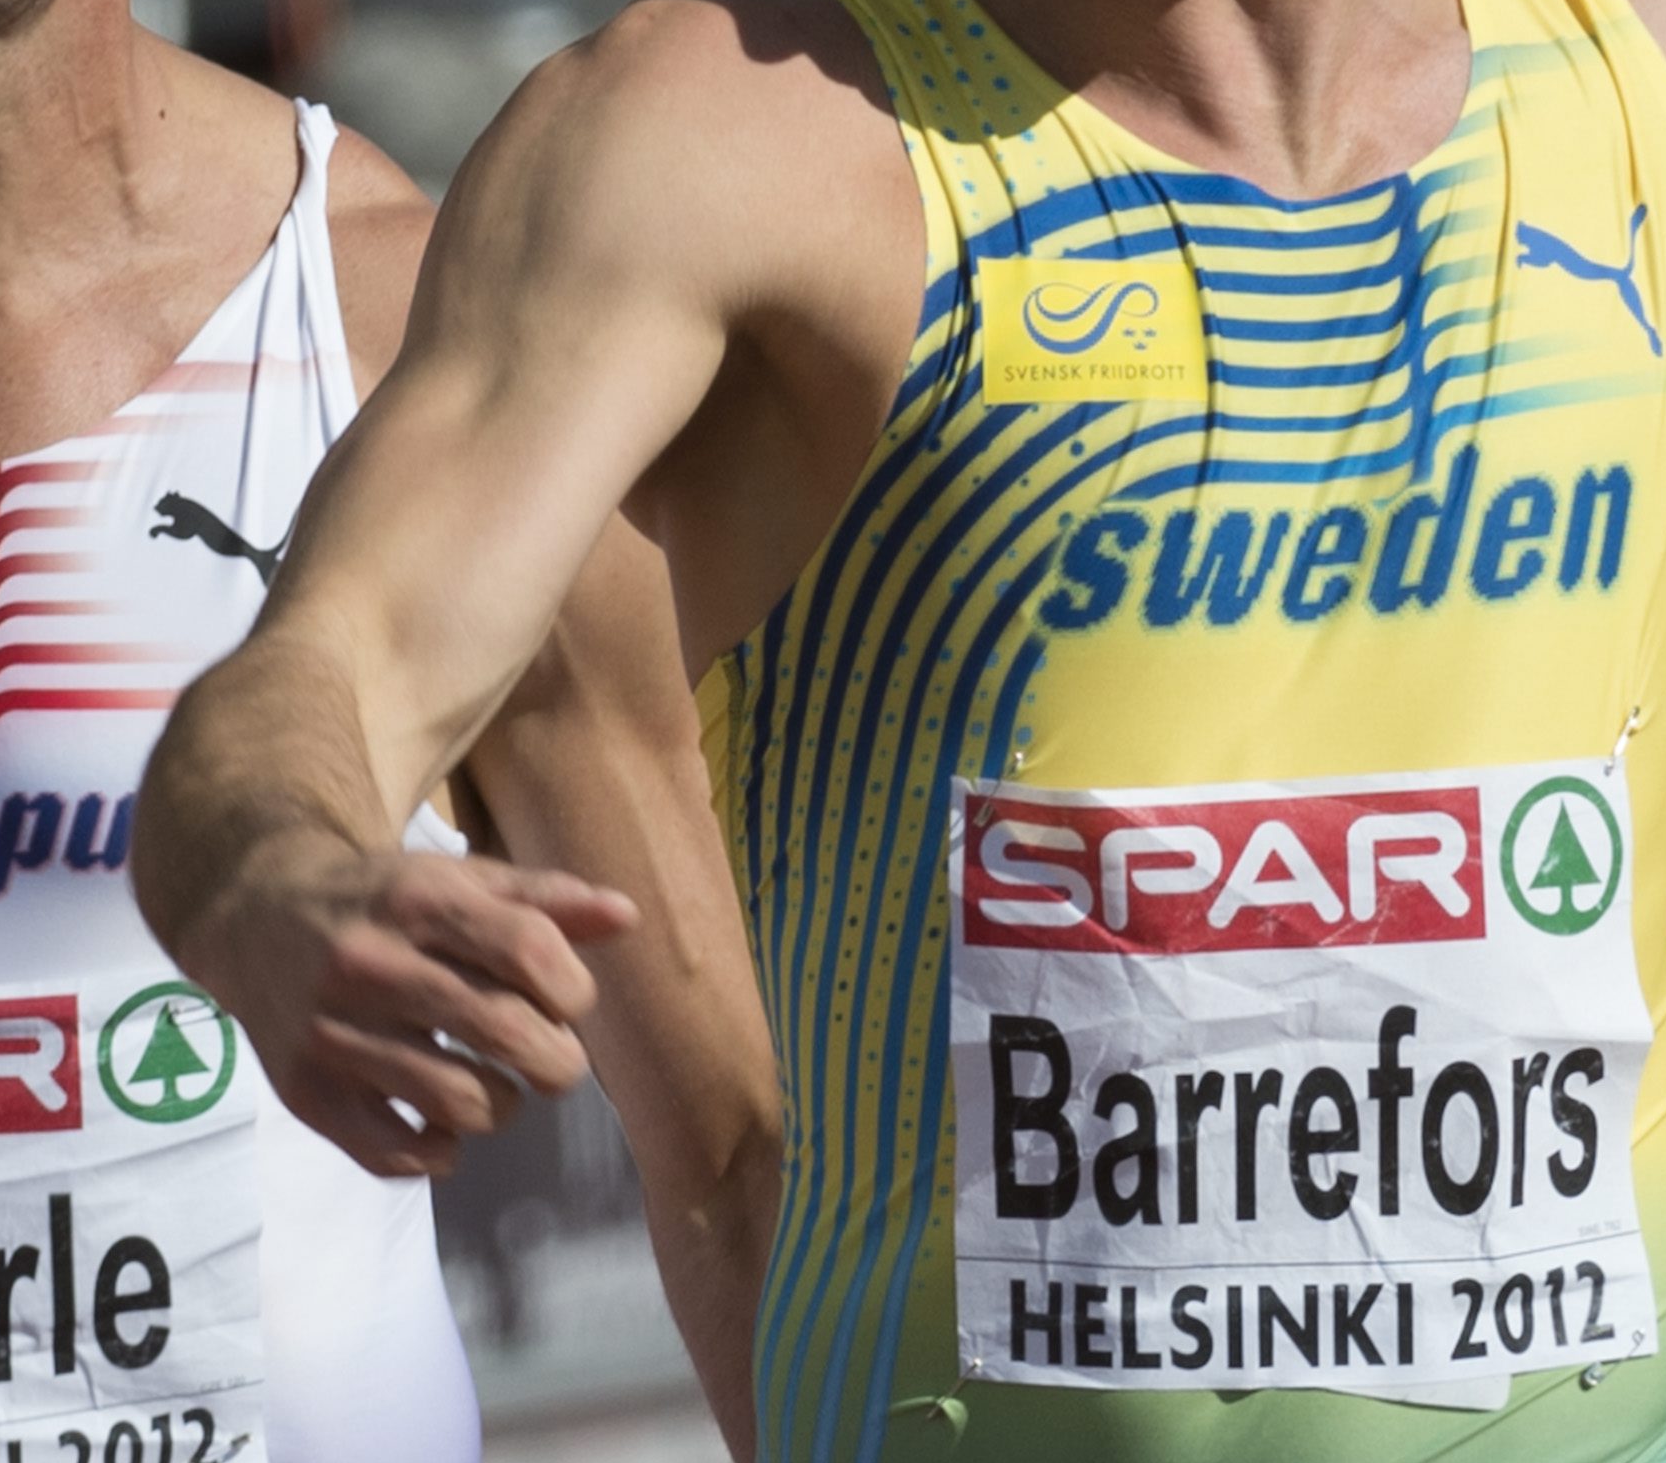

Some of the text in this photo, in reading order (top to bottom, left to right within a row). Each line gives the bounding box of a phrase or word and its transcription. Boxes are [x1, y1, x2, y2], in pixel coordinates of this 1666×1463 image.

[1004, 363, 1186, 383] SVENSK FRIIDROTT
[1035, 440, 1633, 633] sweden
[978, 811, 1473, 931] SPAR
[988, 1004, 1606, 1228] Barrefors
[1008, 1259, 1616, 1370] HELSINKI 2012
